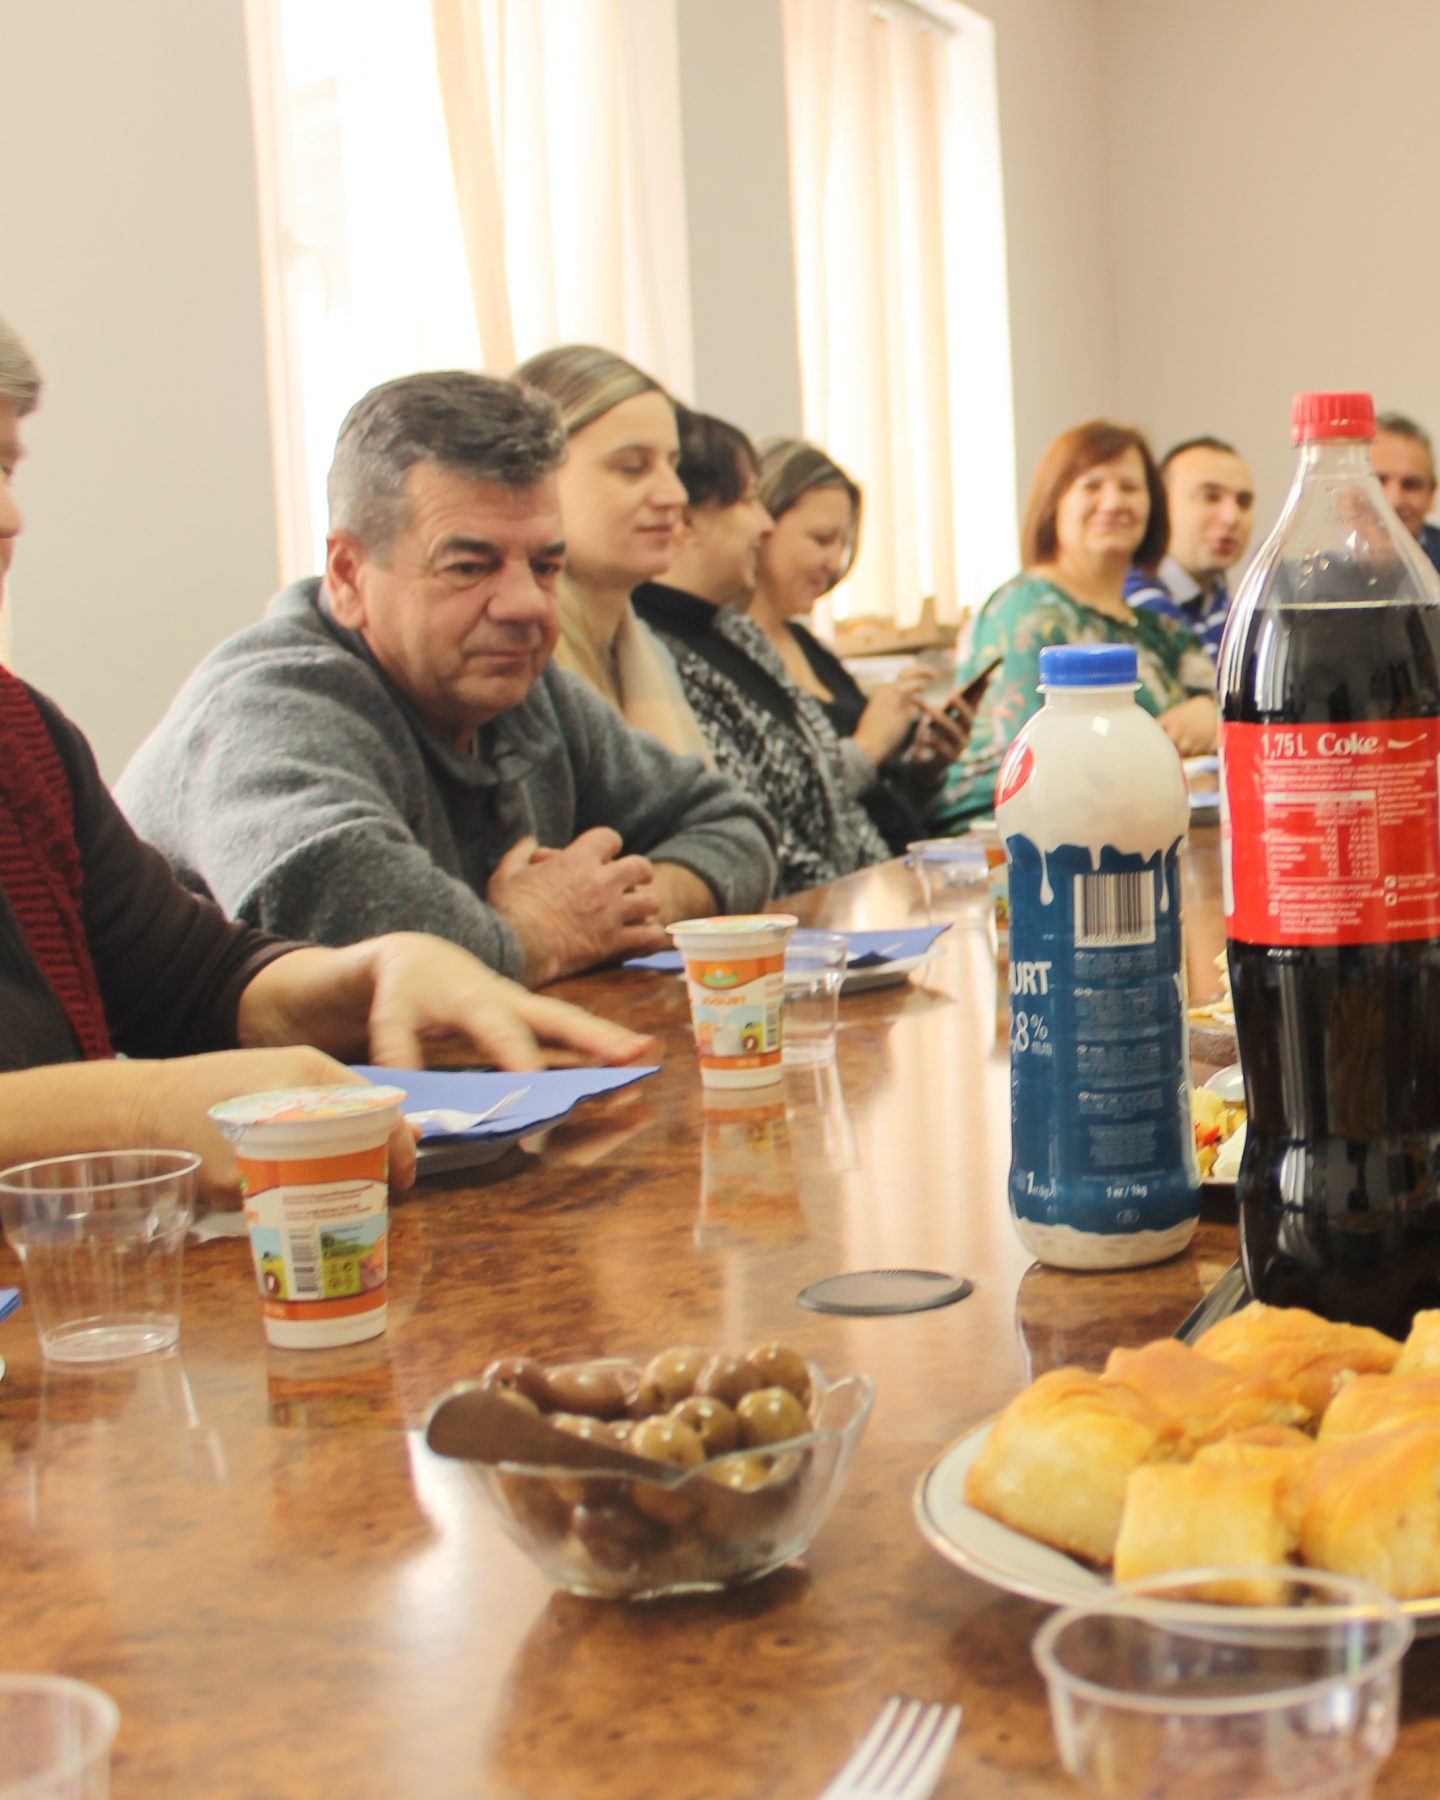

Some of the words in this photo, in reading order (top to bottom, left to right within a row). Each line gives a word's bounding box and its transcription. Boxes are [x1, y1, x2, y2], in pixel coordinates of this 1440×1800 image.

[1261, 732, 1295, 759] 1,75
[1297, 732, 1308, 756] L
[1316, 731, 1380, 757] Coke
